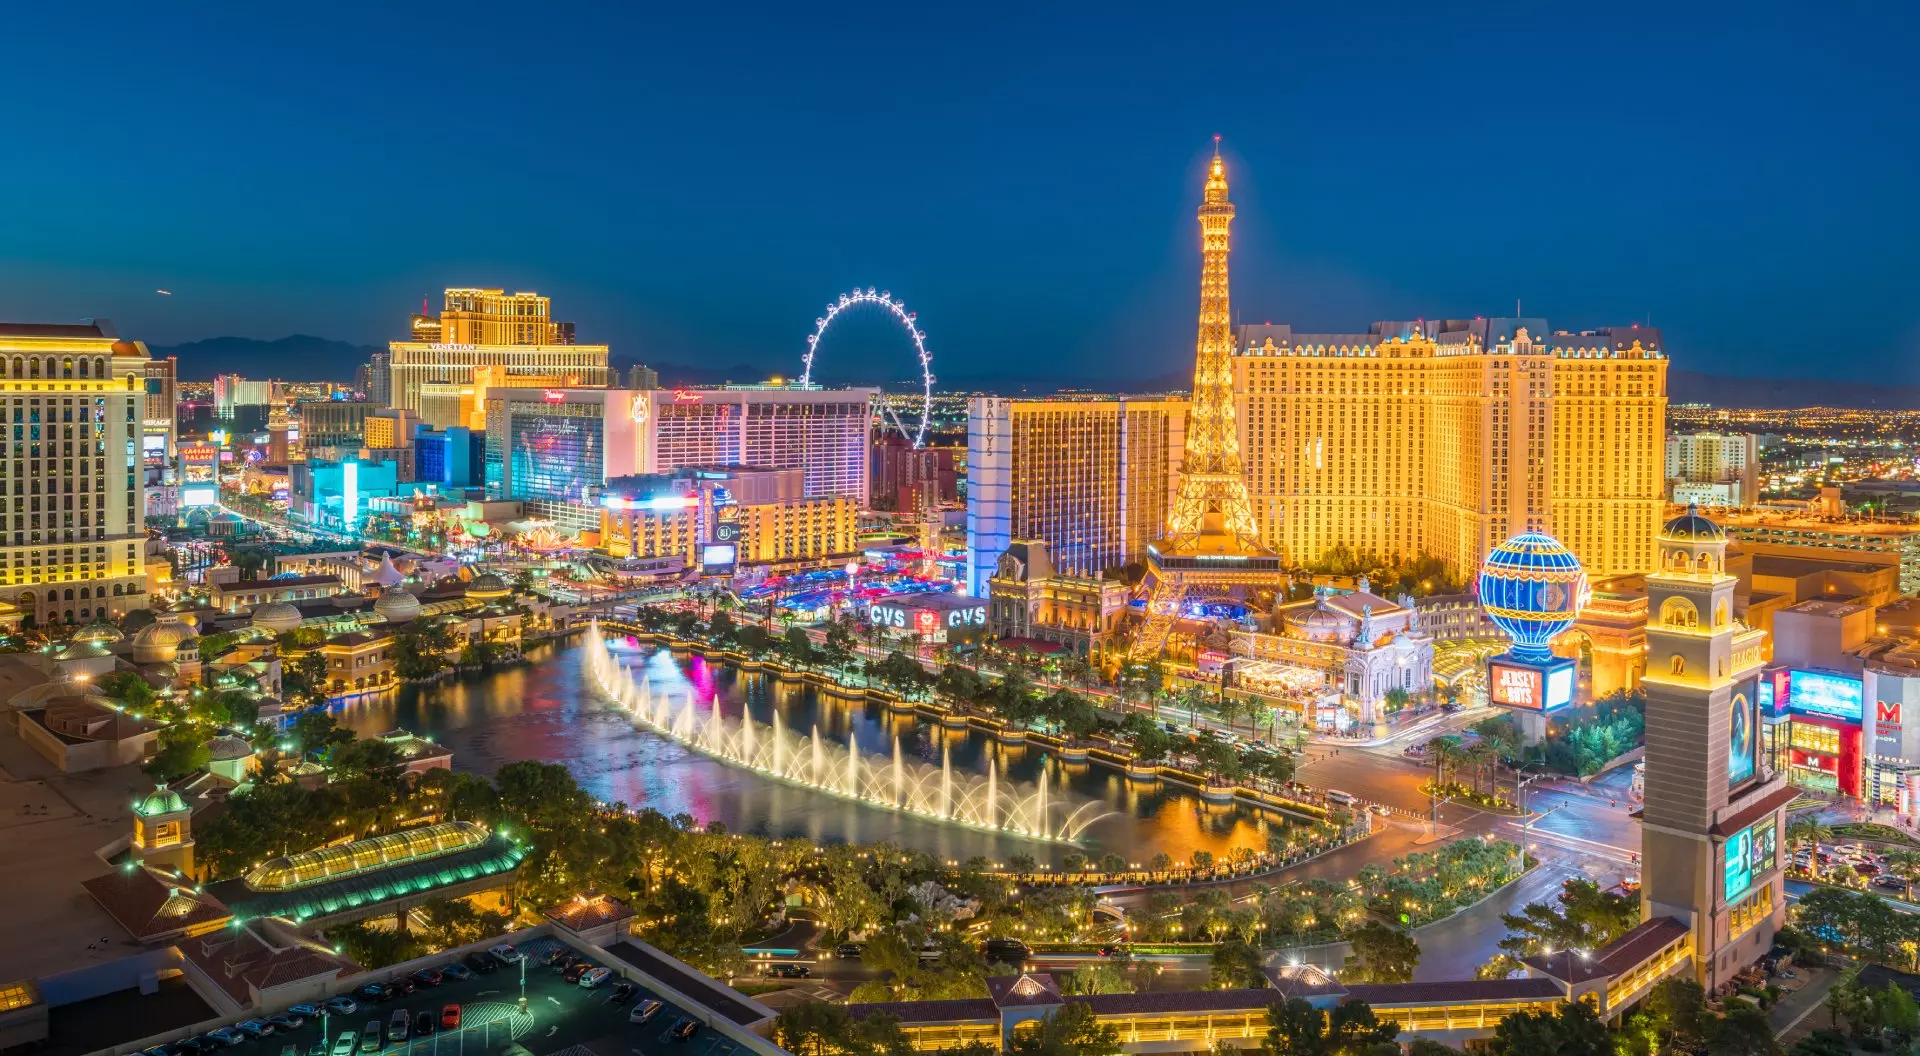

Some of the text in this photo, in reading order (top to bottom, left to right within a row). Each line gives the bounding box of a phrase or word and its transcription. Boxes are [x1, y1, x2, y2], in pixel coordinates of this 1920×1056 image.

[673, 390, 703, 401] Flamingo
[143, 419, 171, 427] MIRAGE
[870, 605, 905, 627] CVS
[948, 606, 986, 627] CVS
[1500, 669, 1535, 689] JERSEY
[1507, 686, 1533, 704] BOYS
[1868, 752, 1910, 764] SEPHORA
